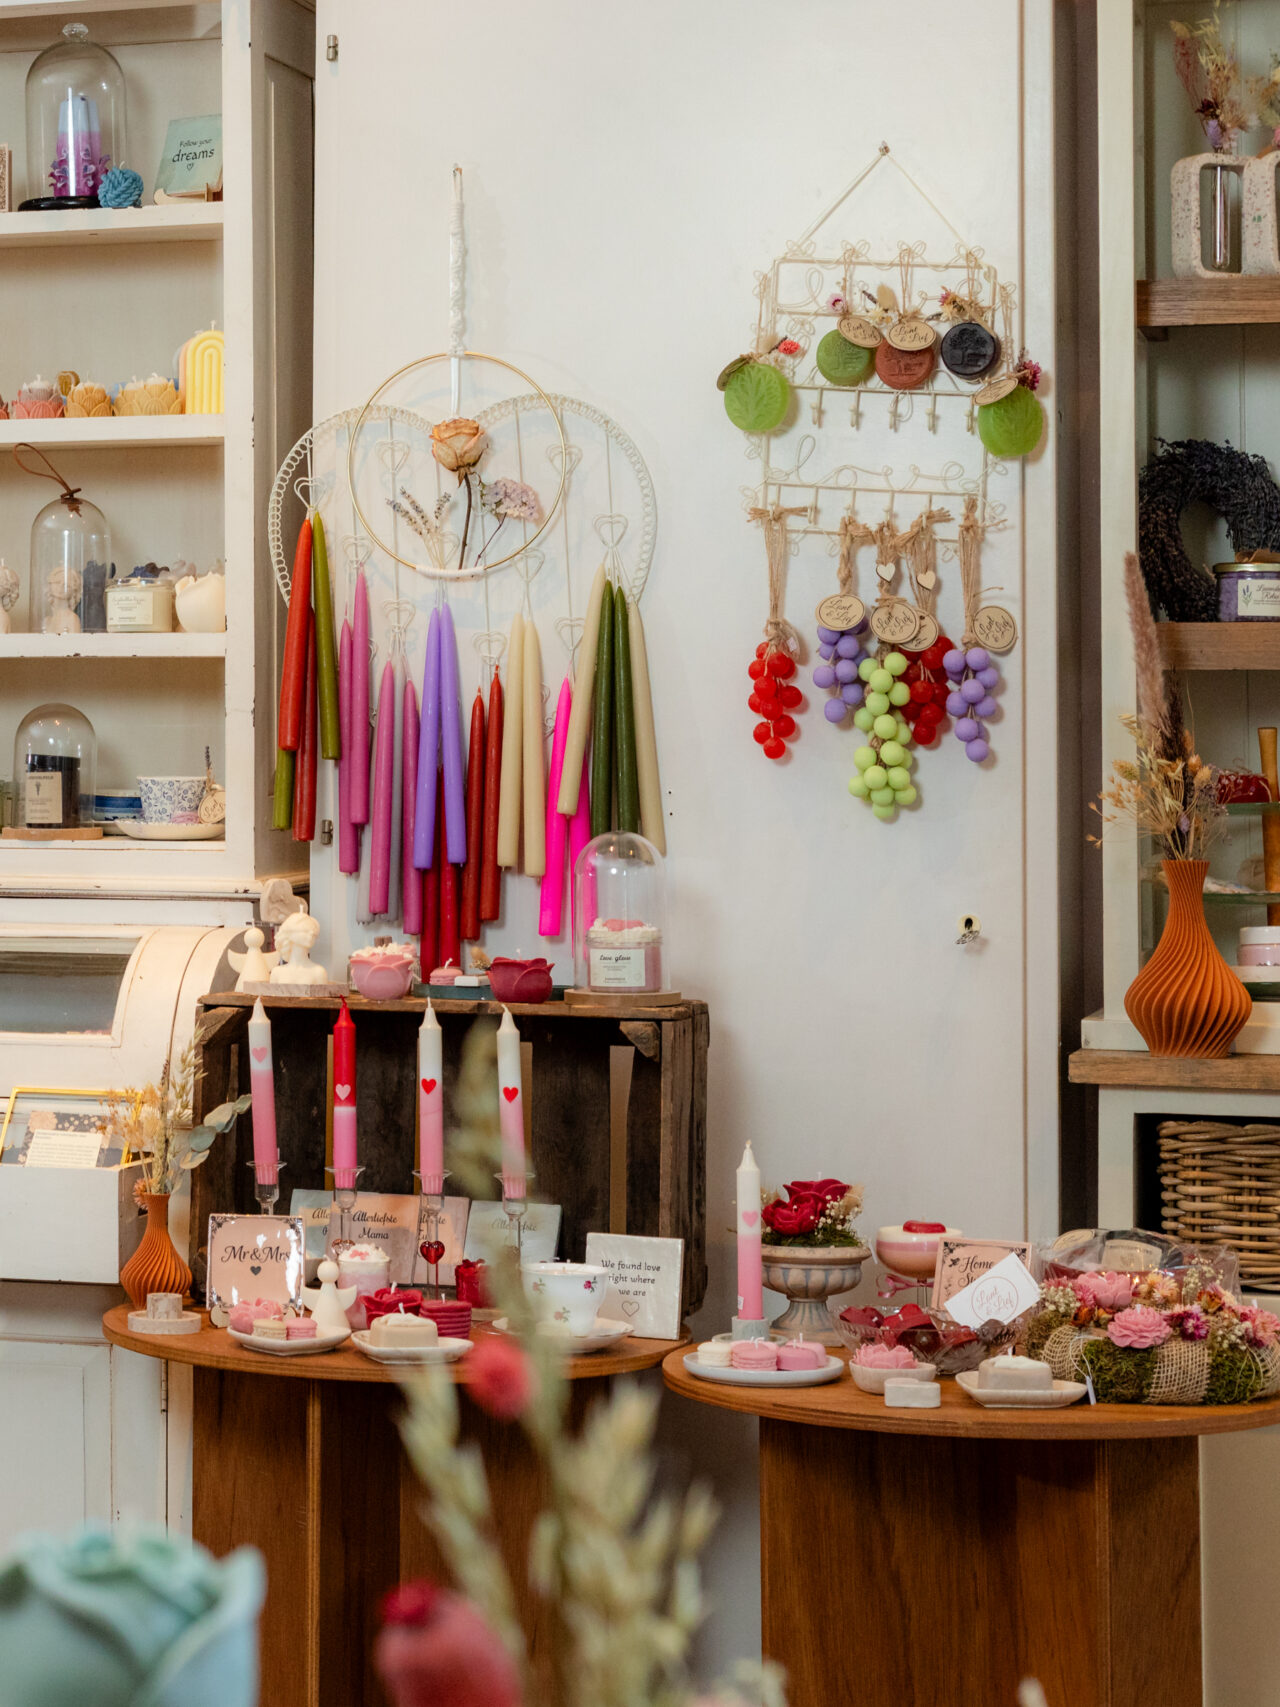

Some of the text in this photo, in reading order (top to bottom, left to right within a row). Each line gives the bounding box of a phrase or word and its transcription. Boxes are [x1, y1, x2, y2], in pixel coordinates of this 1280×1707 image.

[172, 149, 215, 163] dreams
[351, 1209, 398, 1226] Allerliefste
[358, 1226, 390, 1240] Mama
[601, 1259, 661, 1272] We found love
[608, 1273, 656, 1285] right where
[632, 1289, 647, 1297] are
